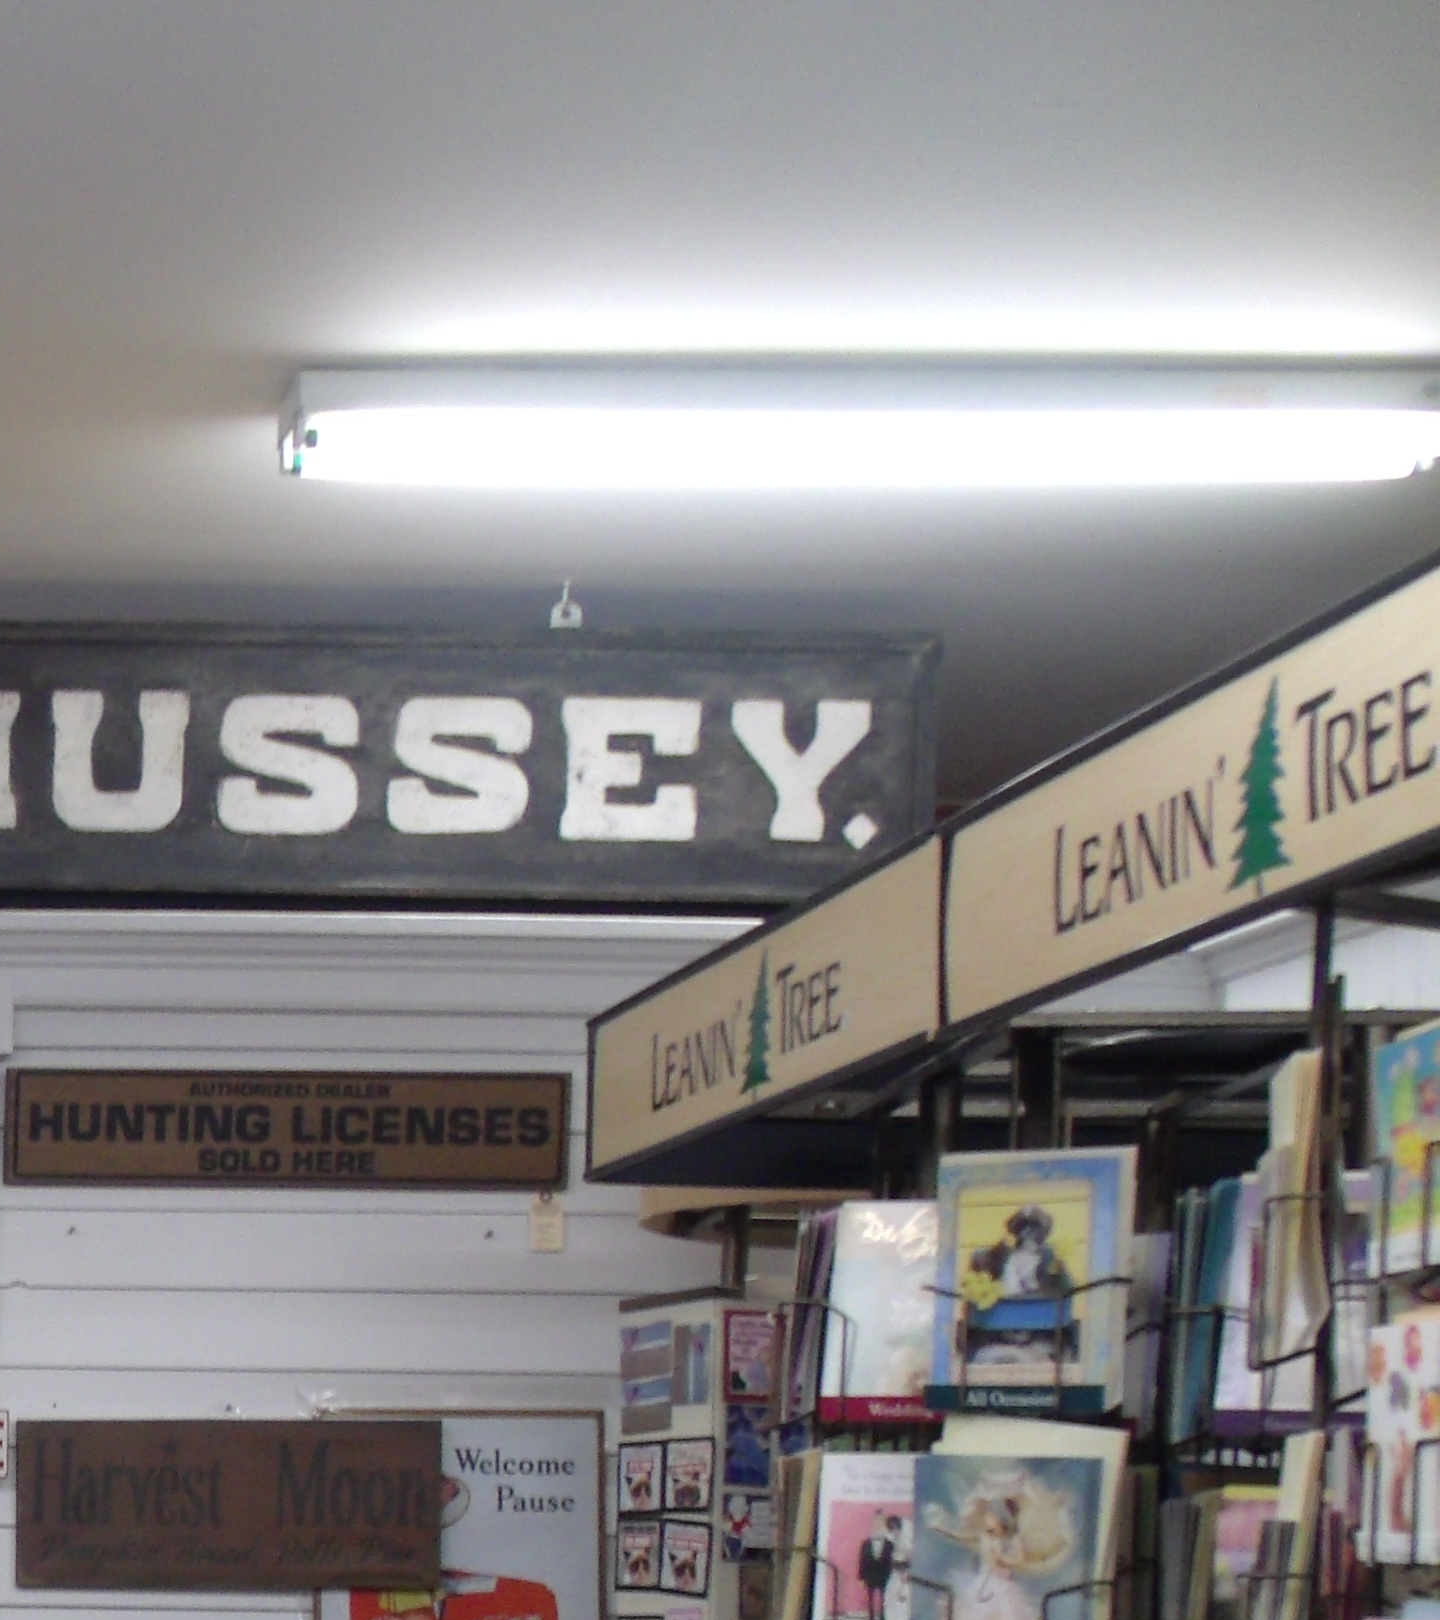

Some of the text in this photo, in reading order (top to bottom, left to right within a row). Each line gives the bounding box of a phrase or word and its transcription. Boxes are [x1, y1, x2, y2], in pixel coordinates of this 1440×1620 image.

[1297, 670, 1436, 822] TREE
[776, 962, 842, 1054] TREE
[189, 1082, 391, 1099] AUTHORIZED DEALER
[28, 1104, 551, 1147] HUNTING LICENSES
[197, 1148, 375, 1173] SOLD HERE
[455, 1448, 576, 1476] Welcome
[31, 1437, 431, 1529] Harvest Moon
[496, 1487, 576, 1514] Pause
